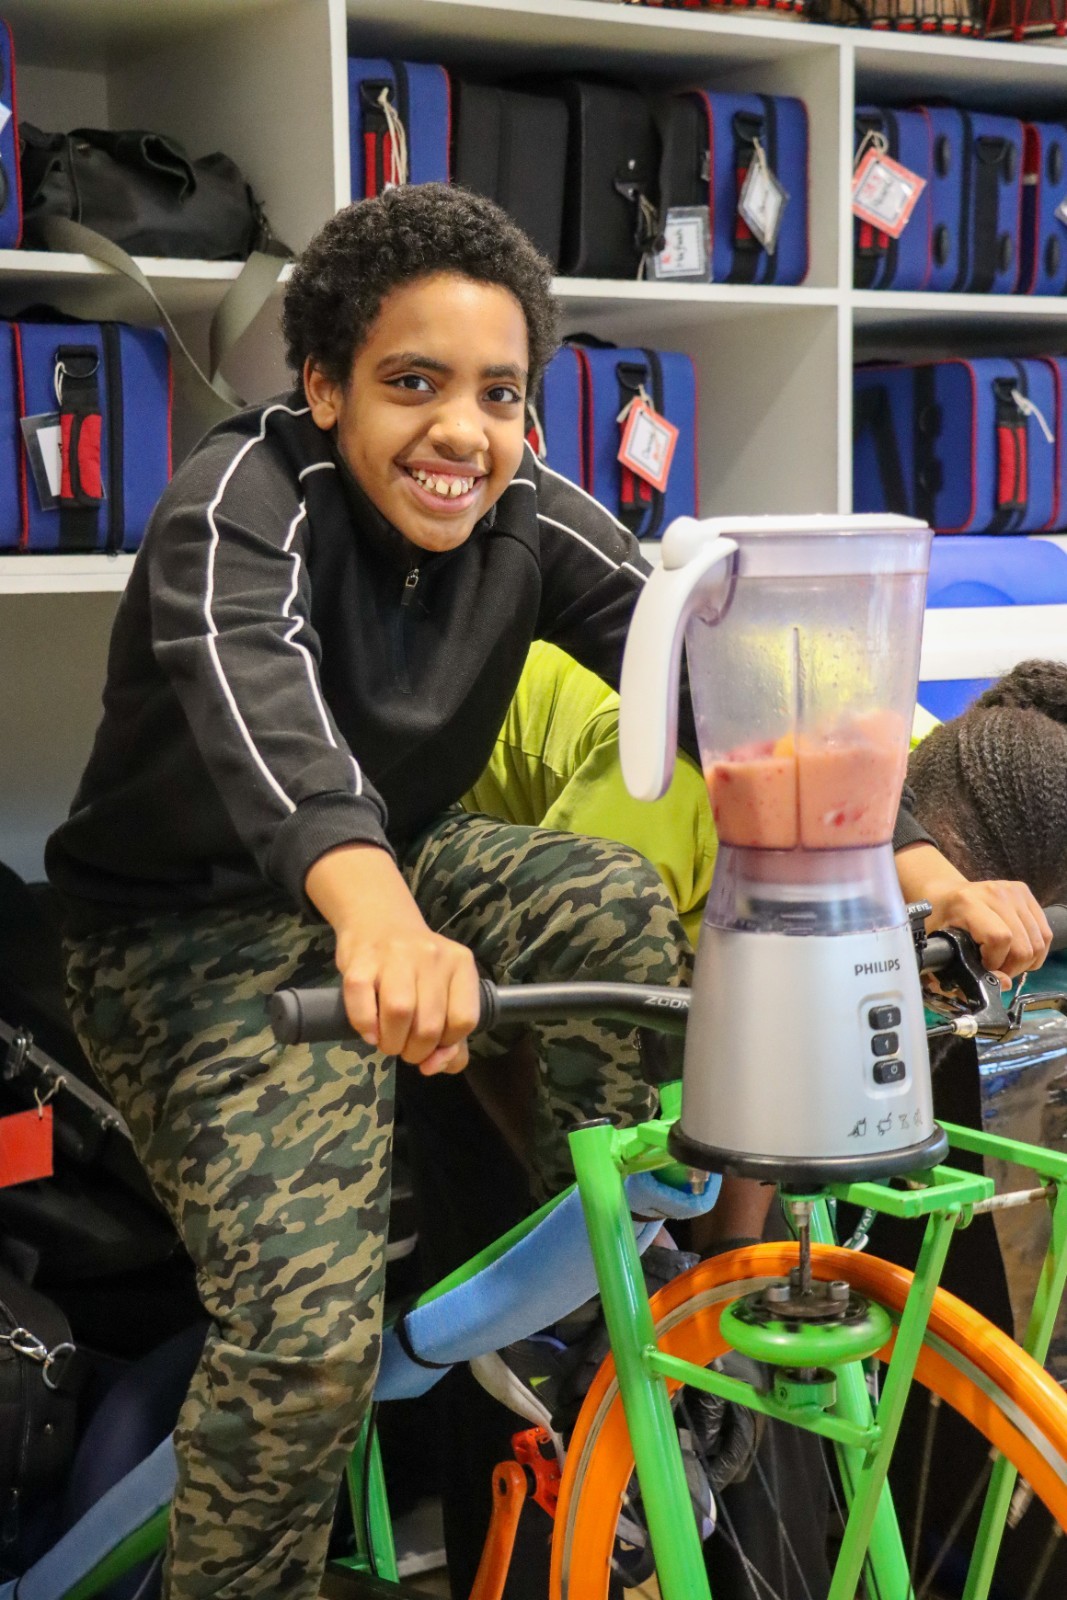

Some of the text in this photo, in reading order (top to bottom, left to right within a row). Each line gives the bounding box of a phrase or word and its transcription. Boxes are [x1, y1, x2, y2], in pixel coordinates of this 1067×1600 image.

[905, 902, 931, 915] ATEYE
[854, 958, 901, 976] PHILIPS
[886, 1012, 893, 1023] 2
[884, 1039, 890, 1049] 1
